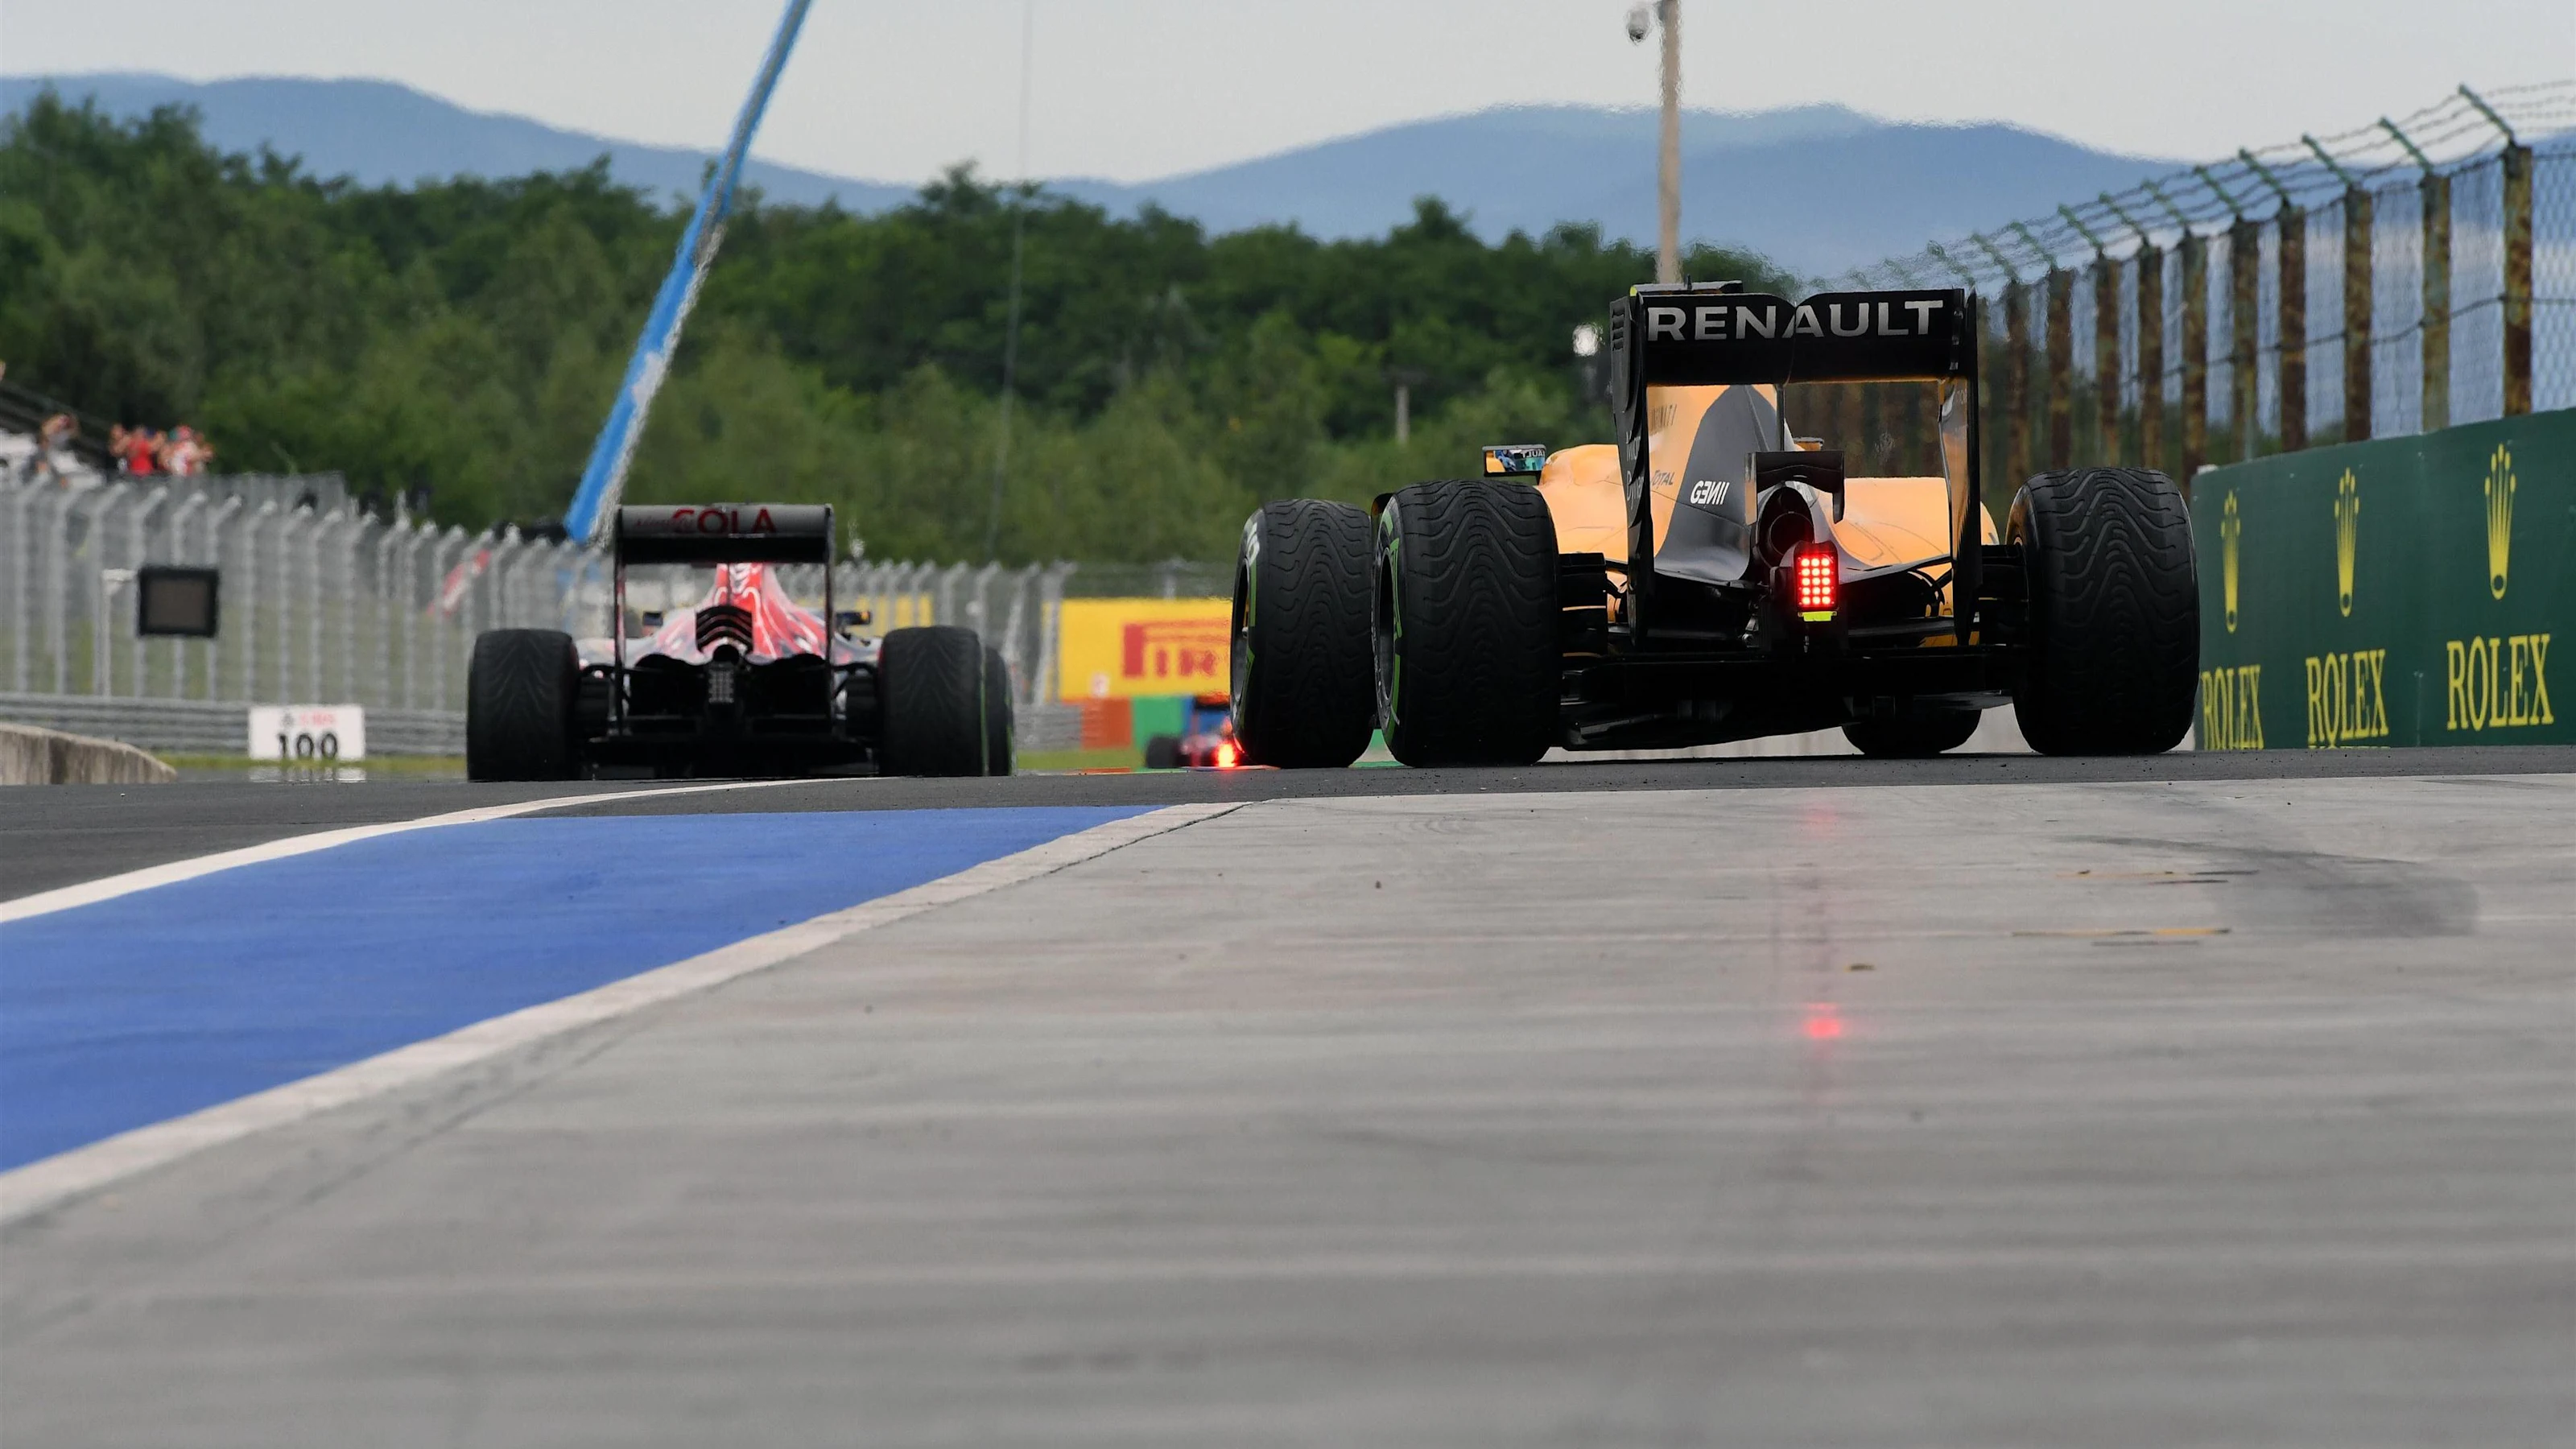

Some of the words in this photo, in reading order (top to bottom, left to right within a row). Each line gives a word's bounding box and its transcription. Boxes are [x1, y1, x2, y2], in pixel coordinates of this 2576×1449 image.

[1648, 300, 1944, 341] RENAULT
[671, 508, 777, 534] COLA
[2201, 665, 2264, 749] ROLEX
[2306, 649, 2389, 744] ROLEX
[2446, 634, 2554, 732] ROLEX
[279, 733, 338, 759] 100
